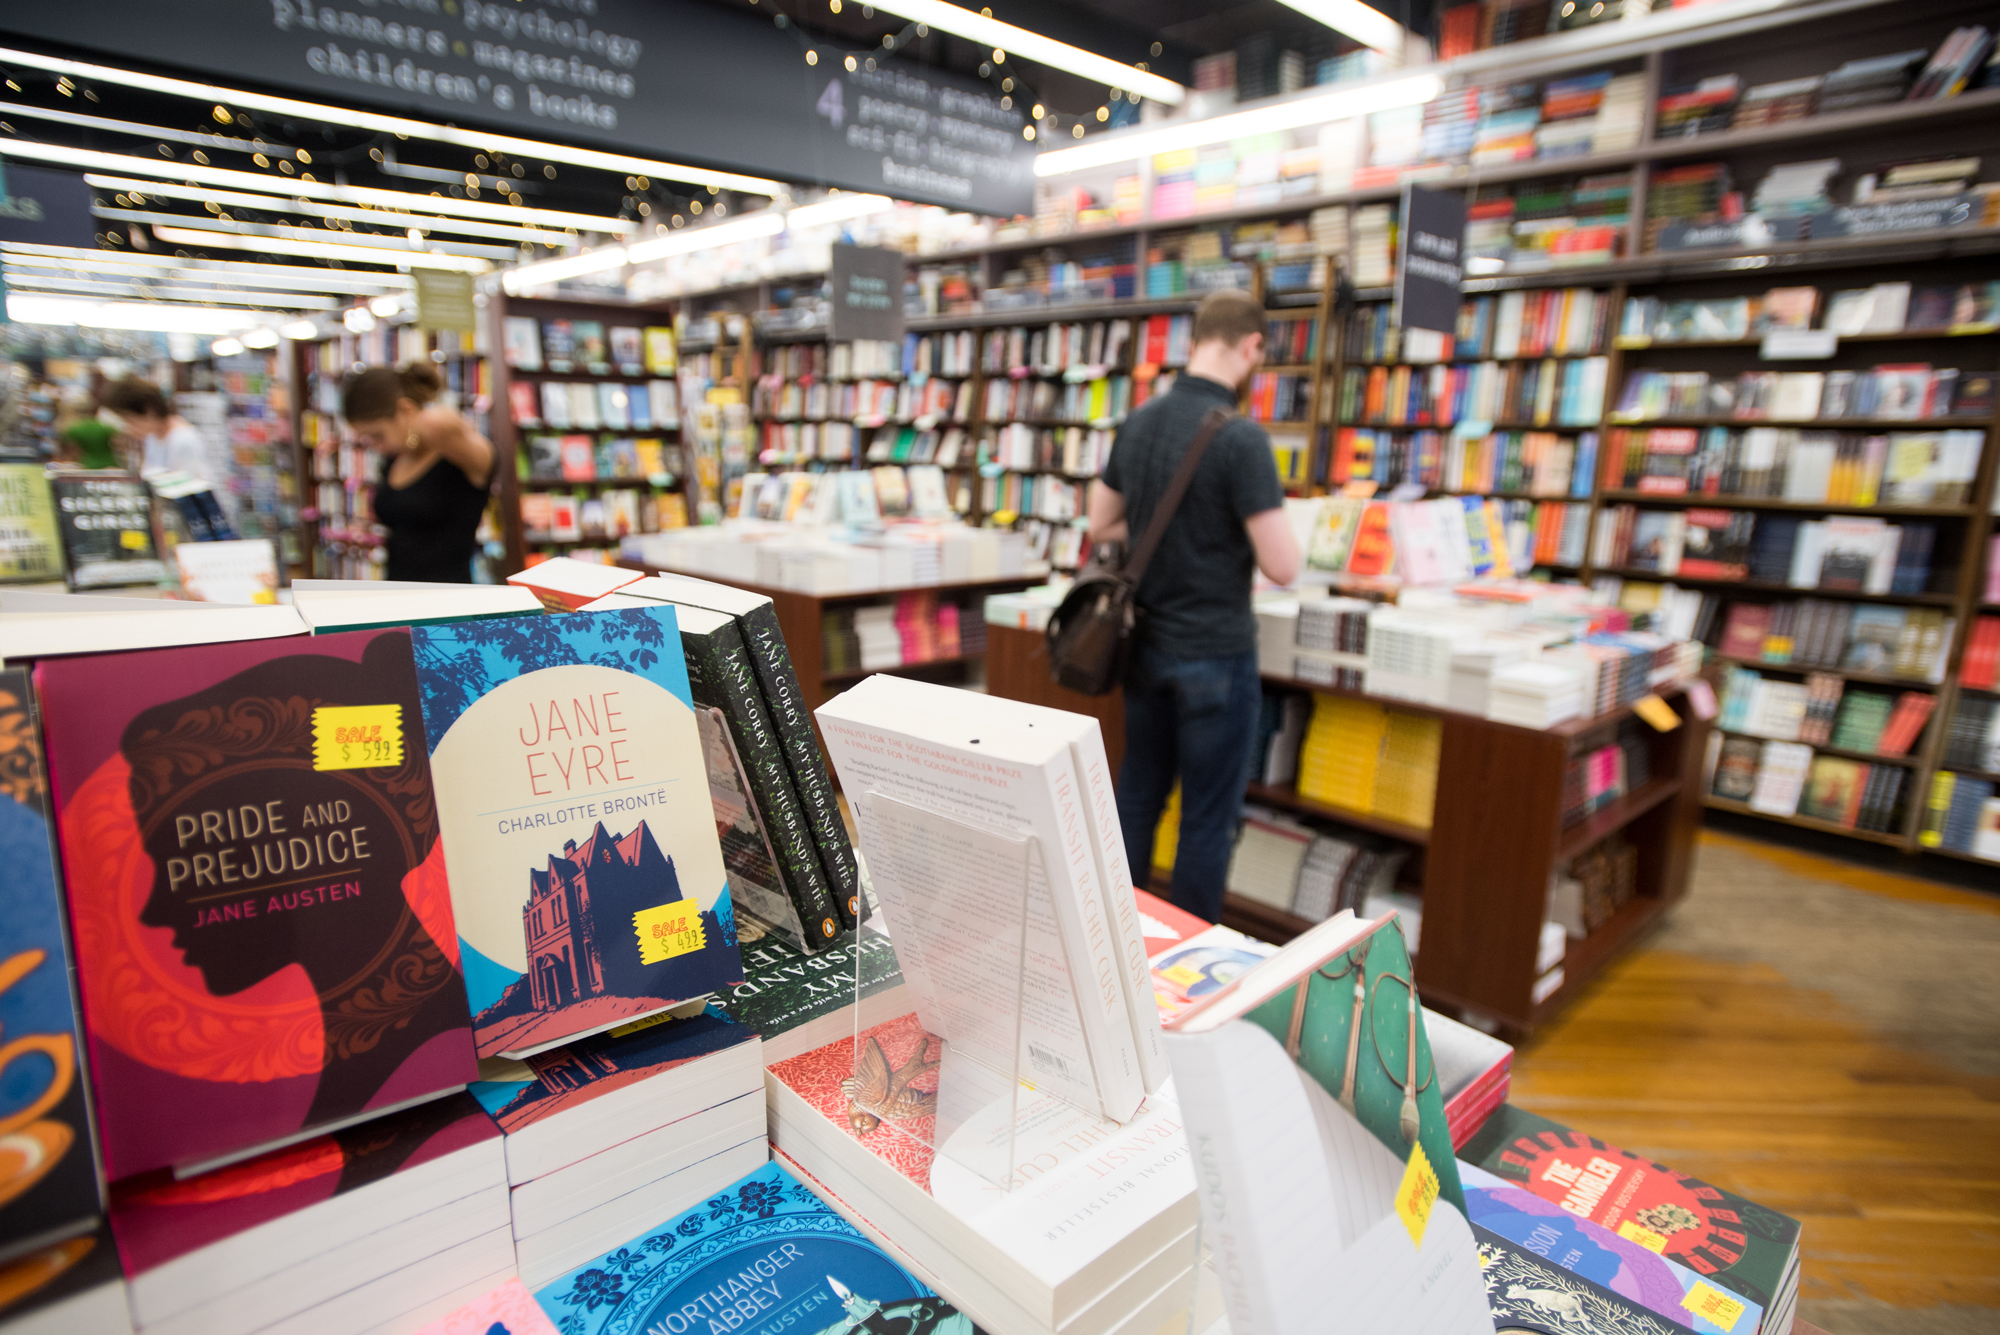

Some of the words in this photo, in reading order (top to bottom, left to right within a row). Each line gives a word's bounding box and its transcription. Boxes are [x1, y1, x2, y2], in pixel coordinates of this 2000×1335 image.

[273, 0, 449, 57] planners
[472, 39, 636, 99] magazines
[464, 0, 643, 69] psychology
[305, 42, 516, 111] children's
[527, 83, 618, 130] books
[815, 78, 845, 131] 4
[60, 495, 151, 513] SILENT
[73, 513, 148, 532] GIRLS
[335, 725, 382, 744] SALE
[518, 691, 628, 748] JANE
[342, 743, 350, 762] $
[526, 738, 635, 796] EYRE
[757, 631, 781, 672] JANE
[775, 676, 799, 726] CORRY
[797, 741, 811, 763] MY
[805, 767, 840, 851] HUSBAND'S
[834, 852, 853, 889] WIFE
[833, 725, 866, 740] FINALIST
[868, 733, 886, 745] FOR
[886, 738, 904, 750] THE
[905, 742, 960, 765] SCOTIABANK
[995, 765, 1022, 780] PRIZE
[851, 740, 884, 756] FINALIST
[886, 749, 904, 761] FOR
[905, 754, 921, 766] THE
[923, 759, 981, 783] GOLDSMITHS
[982, 774, 1009, 790] PRIZE
[725, 653, 750, 694] JANE
[744, 697, 769, 748] CORRY
[767, 763, 782, 786] MY
[776, 789, 813, 873] HUSBAND'S
[807, 874, 826, 912] WIFE
[174, 800, 288, 849] PRIDE
[301, 799, 352, 830] AND
[497, 801, 598, 837] CHARLOTTE
[602, 789, 669, 821] BRONTË
[166, 826, 371, 893] PREJUDICE
[1088, 762, 1117, 853] TRANSIT
[1108, 856, 1134, 935] RACHEL
[1126, 939, 1147, 995] CUSK
[192, 903, 259, 928] JANE
[266, 880, 362, 915] AUSTEN
[1054, 772, 1086, 867] TRANSIT
[1076, 871, 1103, 952] RACHEL
[1096, 956, 1120, 1015] CUSK
[651, 916, 689, 940] SALE
[661, 937, 670, 955] $
[1045, 1117, 1081, 1137] OUTLINE
[1086, 1117, 1184, 1181] TRANSIT
[981, 1152, 1059, 1200] CUSK
[1407, 1169, 1429, 1216] SALE
[1540, 1158, 1584, 1189] THE
[1560, 1156, 1622, 1219] GAMBLER
[1042, 1180, 1136, 1242] BESTSELLER
[647, 1242, 805, 1335] NORTHANGER
[706, 1279, 786, 1335] ABBEY
